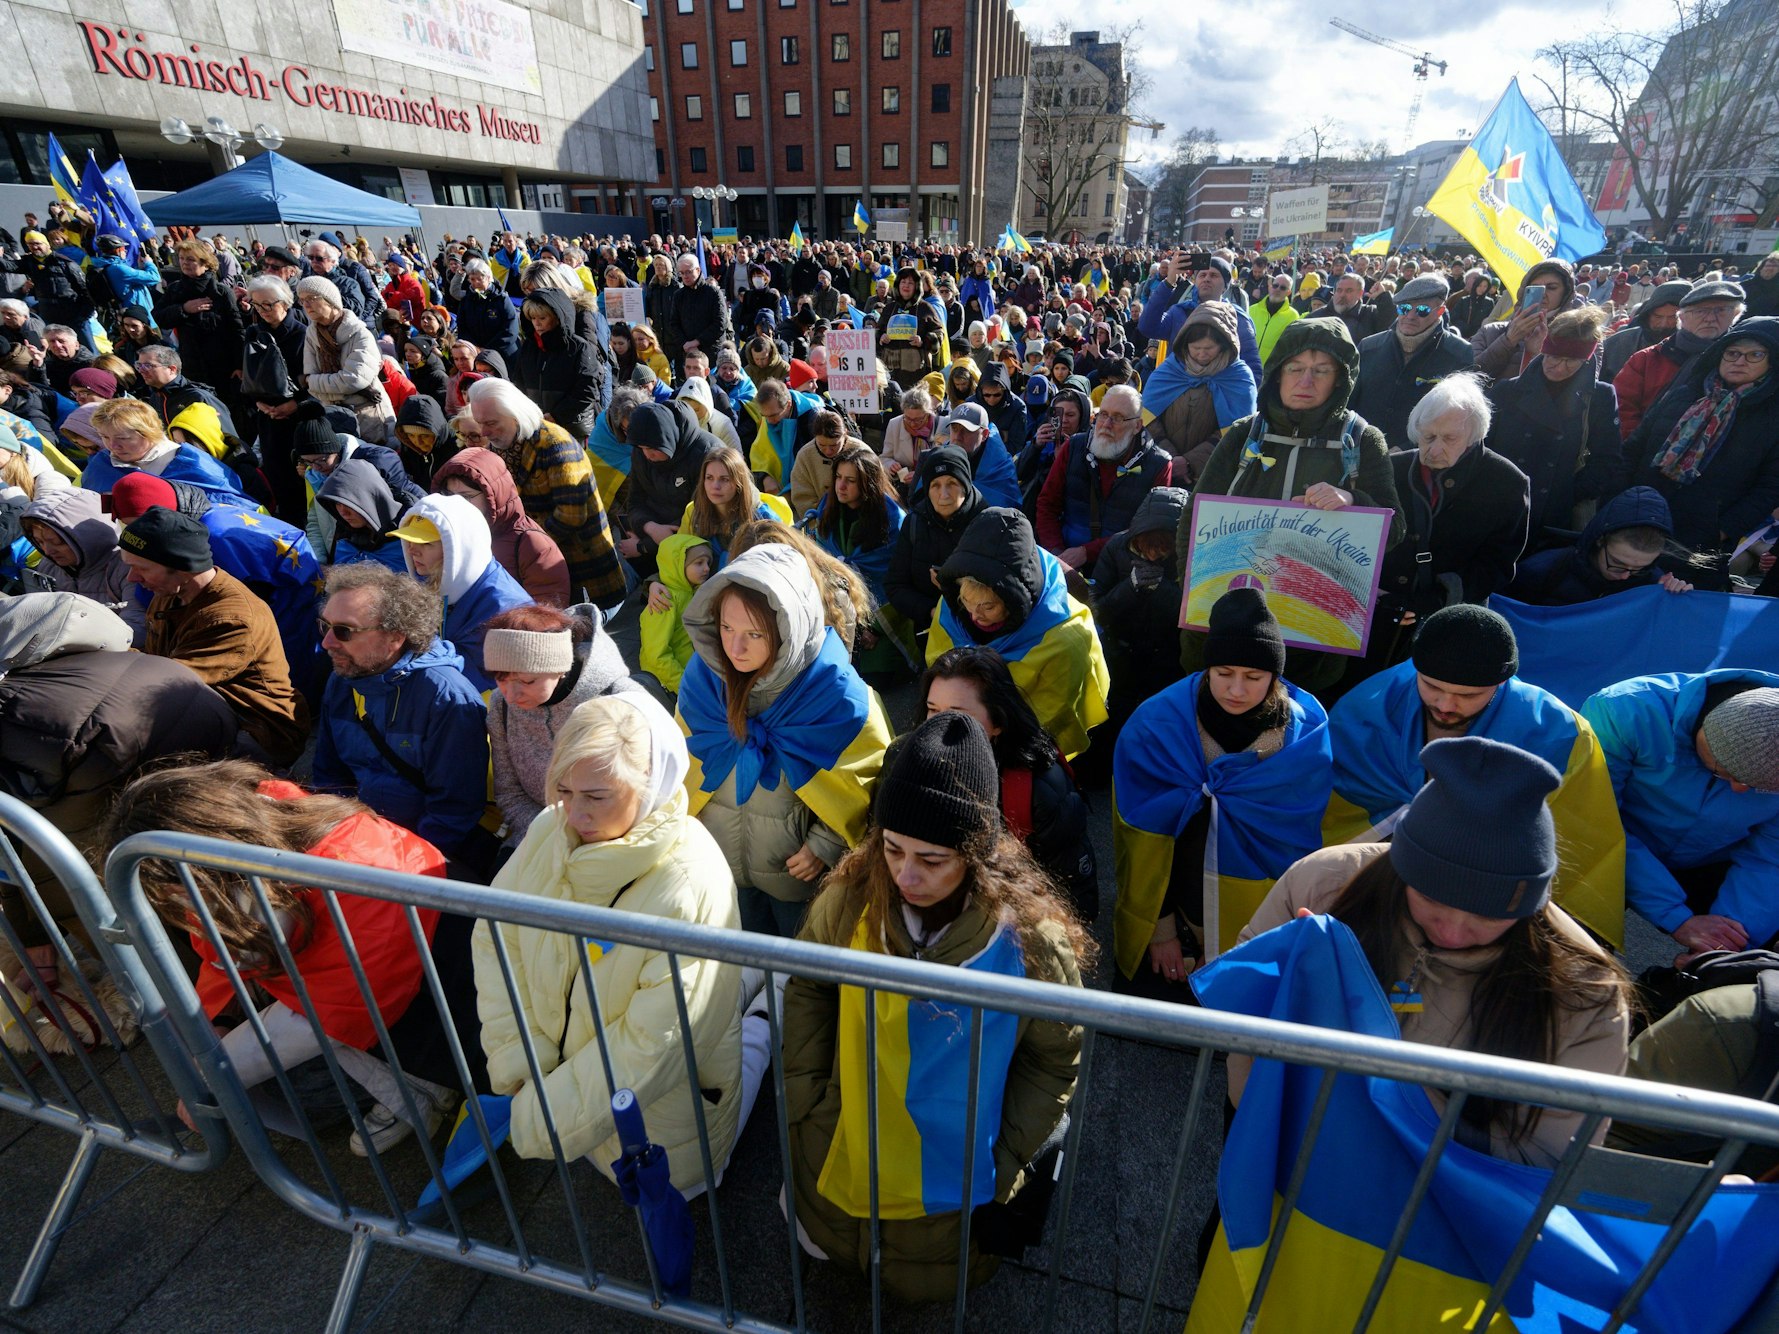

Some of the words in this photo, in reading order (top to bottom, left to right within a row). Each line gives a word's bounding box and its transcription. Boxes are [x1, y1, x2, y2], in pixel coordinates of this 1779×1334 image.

[77, 21, 472, 133] Römisch-Germanisches
[477, 103, 542, 145] Museu
[1275, 199, 1306, 210] Waffen
[1307, 198, 1320, 206] für
[1272, 216, 1285, 225] die
[1286, 212, 1321, 223] Ukraine!
[826, 331, 870, 351] RUSSIA
[839, 357, 849, 371] IS
[857, 357, 865, 371] A
[841, 398, 869, 408] TATE
[1198, 508, 1278, 544] Solidarität
[1280, 510, 1308, 530] mit
[1301, 518, 1327, 537] der
[1327, 527, 1372, 567] Ukraine
